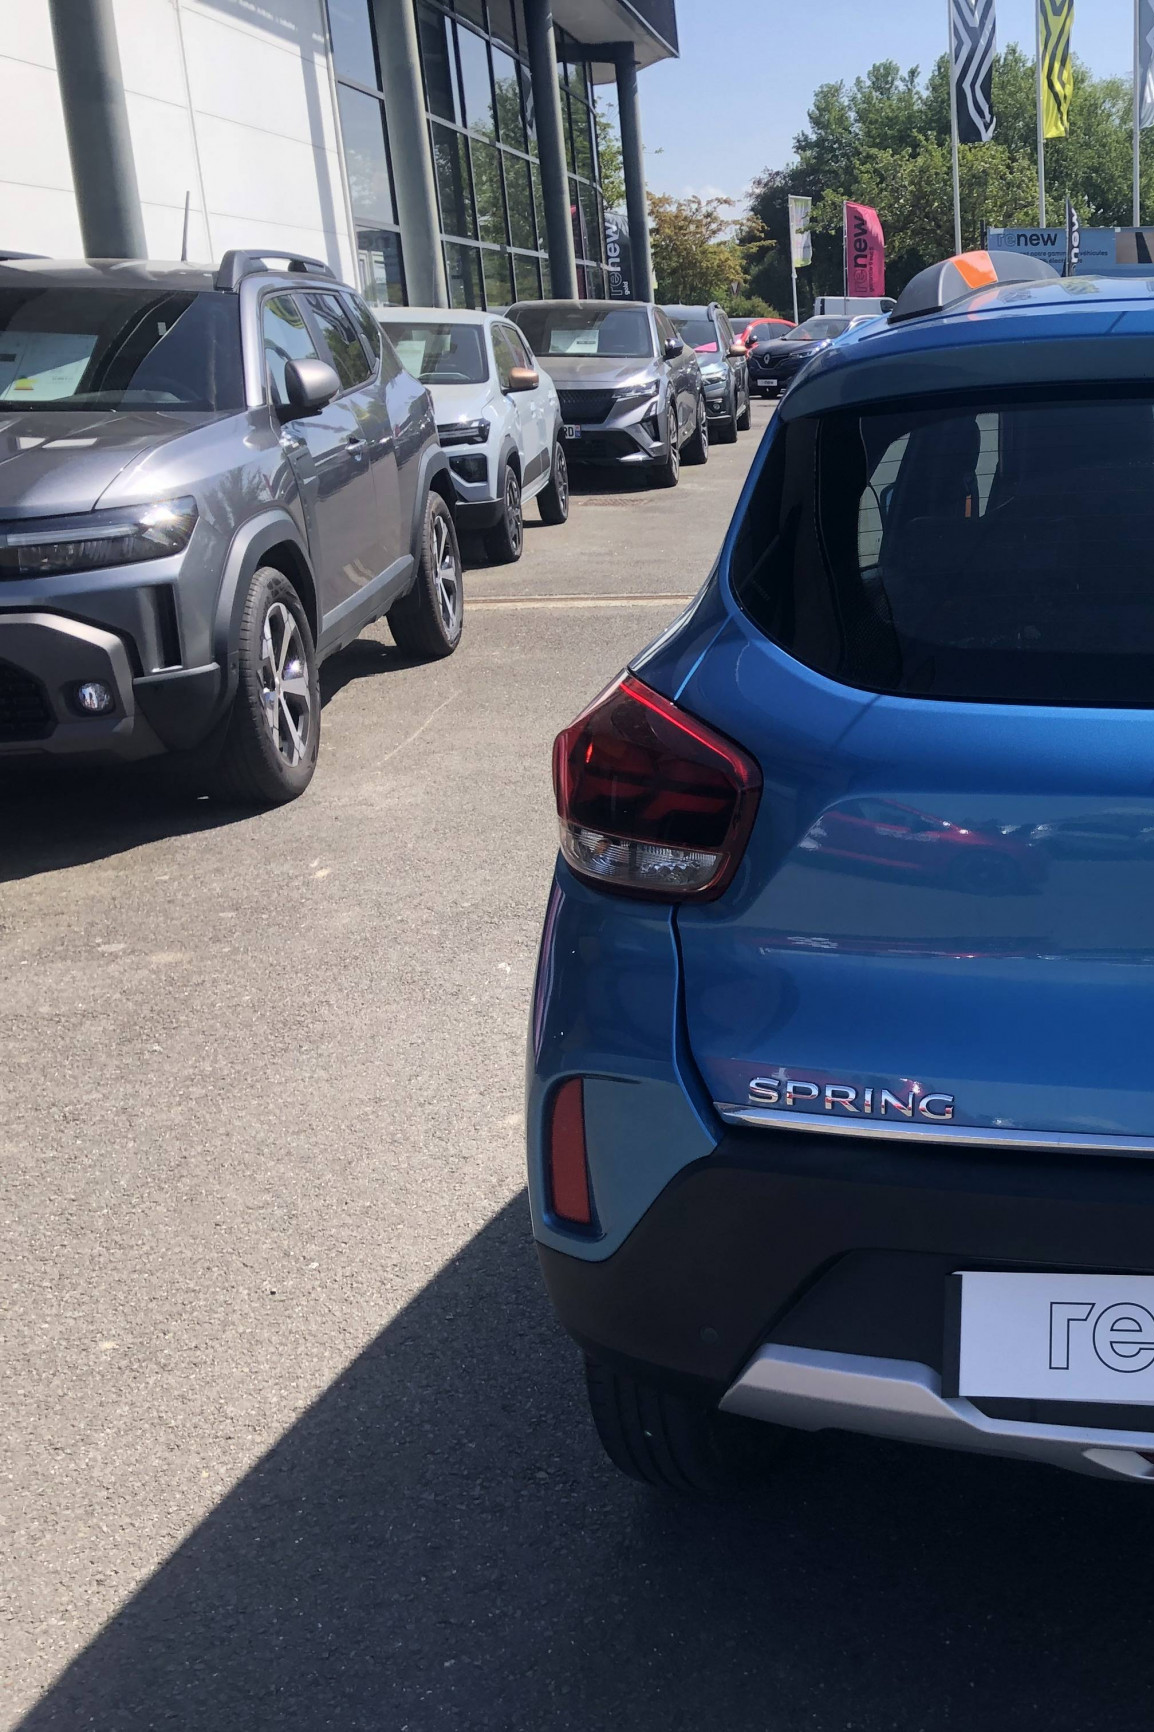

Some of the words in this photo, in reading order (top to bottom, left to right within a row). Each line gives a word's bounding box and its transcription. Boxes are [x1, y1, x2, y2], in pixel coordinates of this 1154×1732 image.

[605, 221, 623, 296] renew
[853, 215, 868, 293] renew
[996, 233, 1058, 247] renew
[748, 1077, 955, 1120] SPRING
